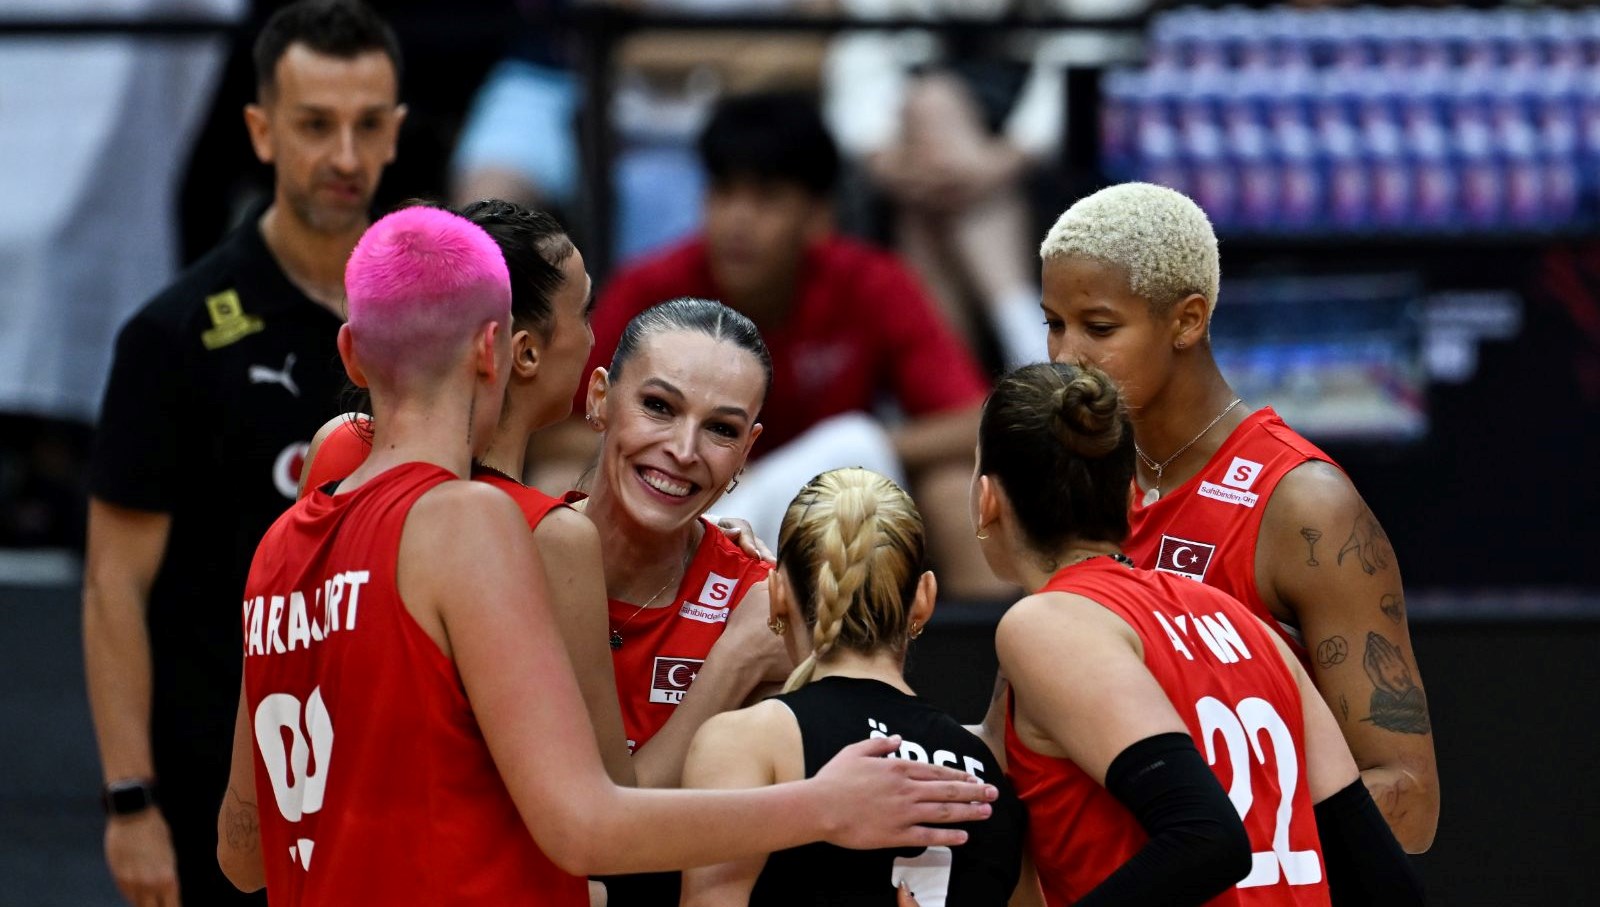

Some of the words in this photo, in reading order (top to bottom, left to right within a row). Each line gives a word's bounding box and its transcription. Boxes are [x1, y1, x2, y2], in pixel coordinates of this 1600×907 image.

[1233, 465, 1252, 482] S
[709, 582, 729, 601] S
[1195, 696, 1322, 889] 22
